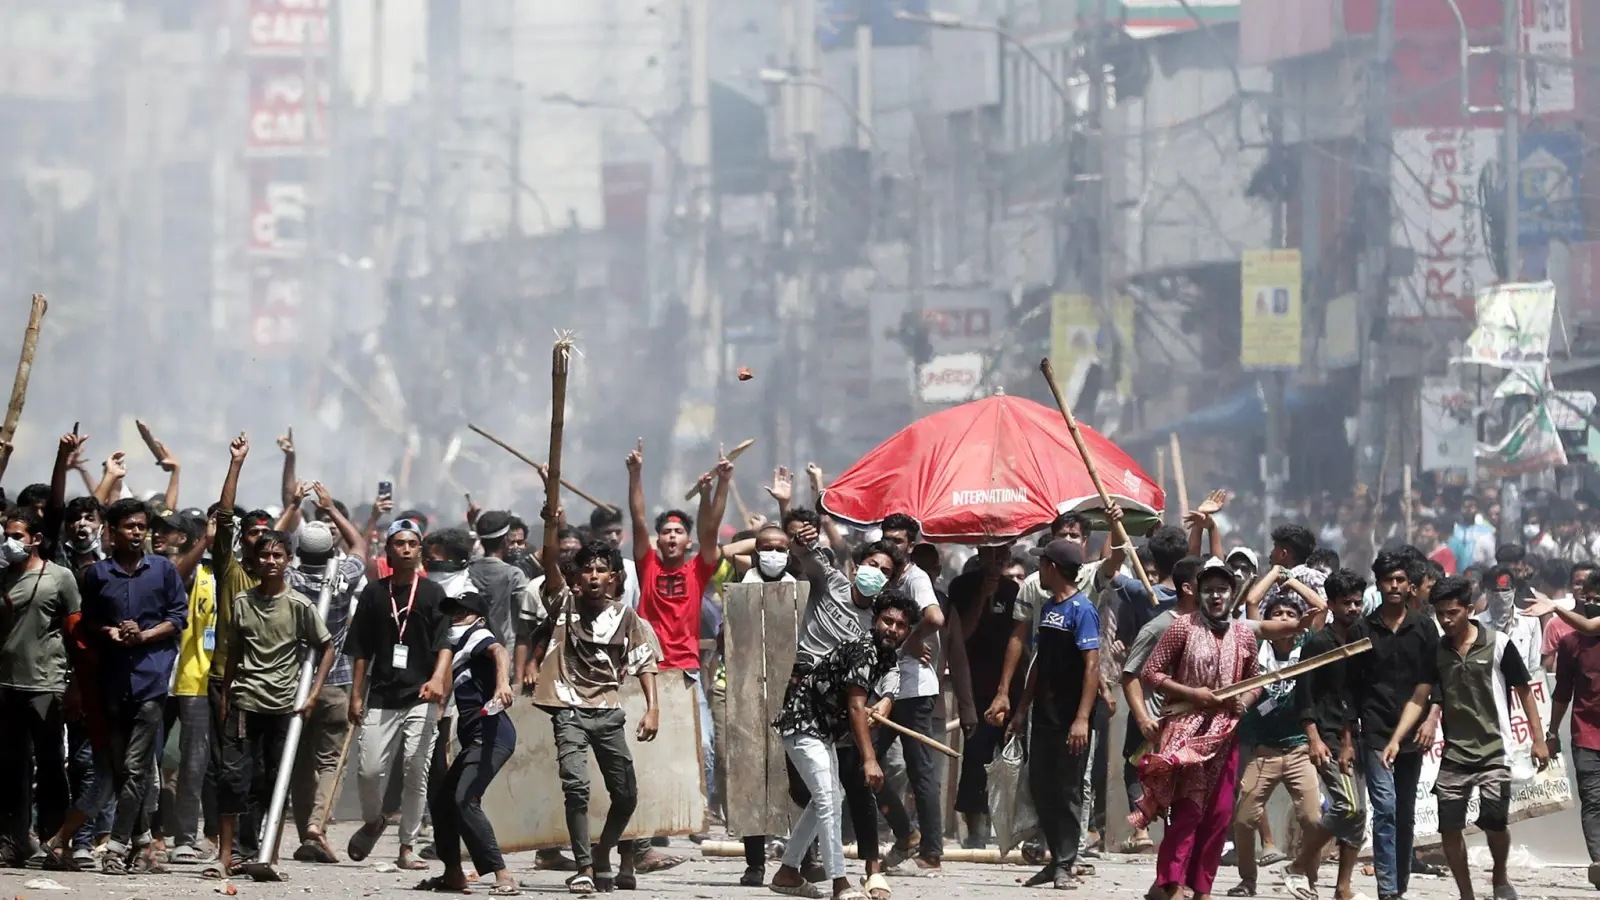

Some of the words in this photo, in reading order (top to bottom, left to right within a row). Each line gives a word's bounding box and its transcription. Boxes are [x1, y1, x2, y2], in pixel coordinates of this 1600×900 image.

[952, 487, 1030, 506] INTERNATIONAL
[825, 601, 843, 621] The
[627, 643, 650, 667] NIKE
